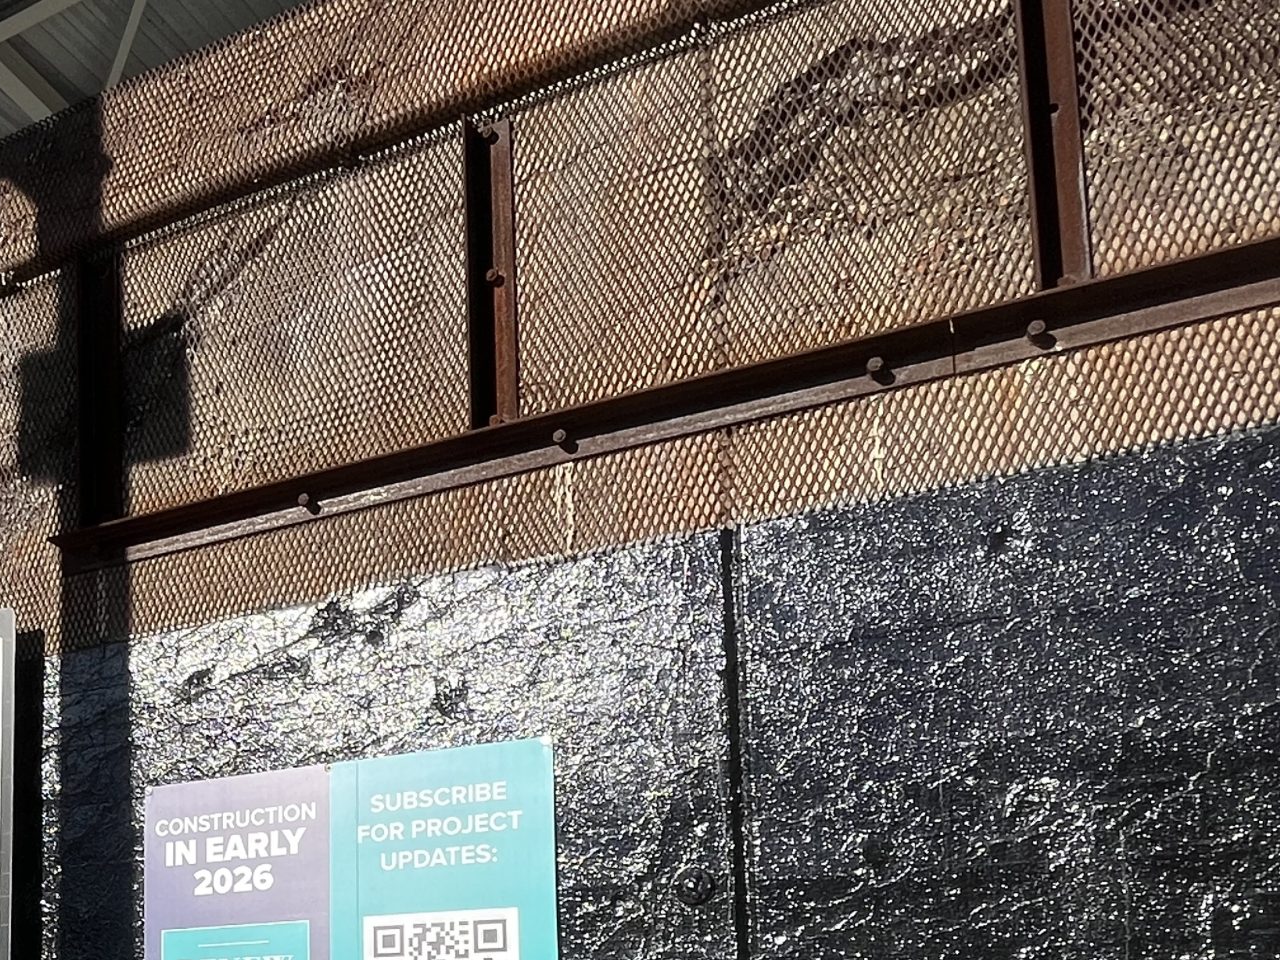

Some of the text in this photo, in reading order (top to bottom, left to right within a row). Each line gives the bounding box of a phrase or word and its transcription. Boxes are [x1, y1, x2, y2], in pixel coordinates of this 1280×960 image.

[369, 781, 506, 812] SUBSCRIBE
[154, 802, 315, 835] CONSTRUCTION
[356, 810, 521, 843] FOR PROJECT
[164, 827, 305, 865] IN EARLY
[379, 845, 497, 870] UPDATES:
[193, 864, 273, 894] 2026
